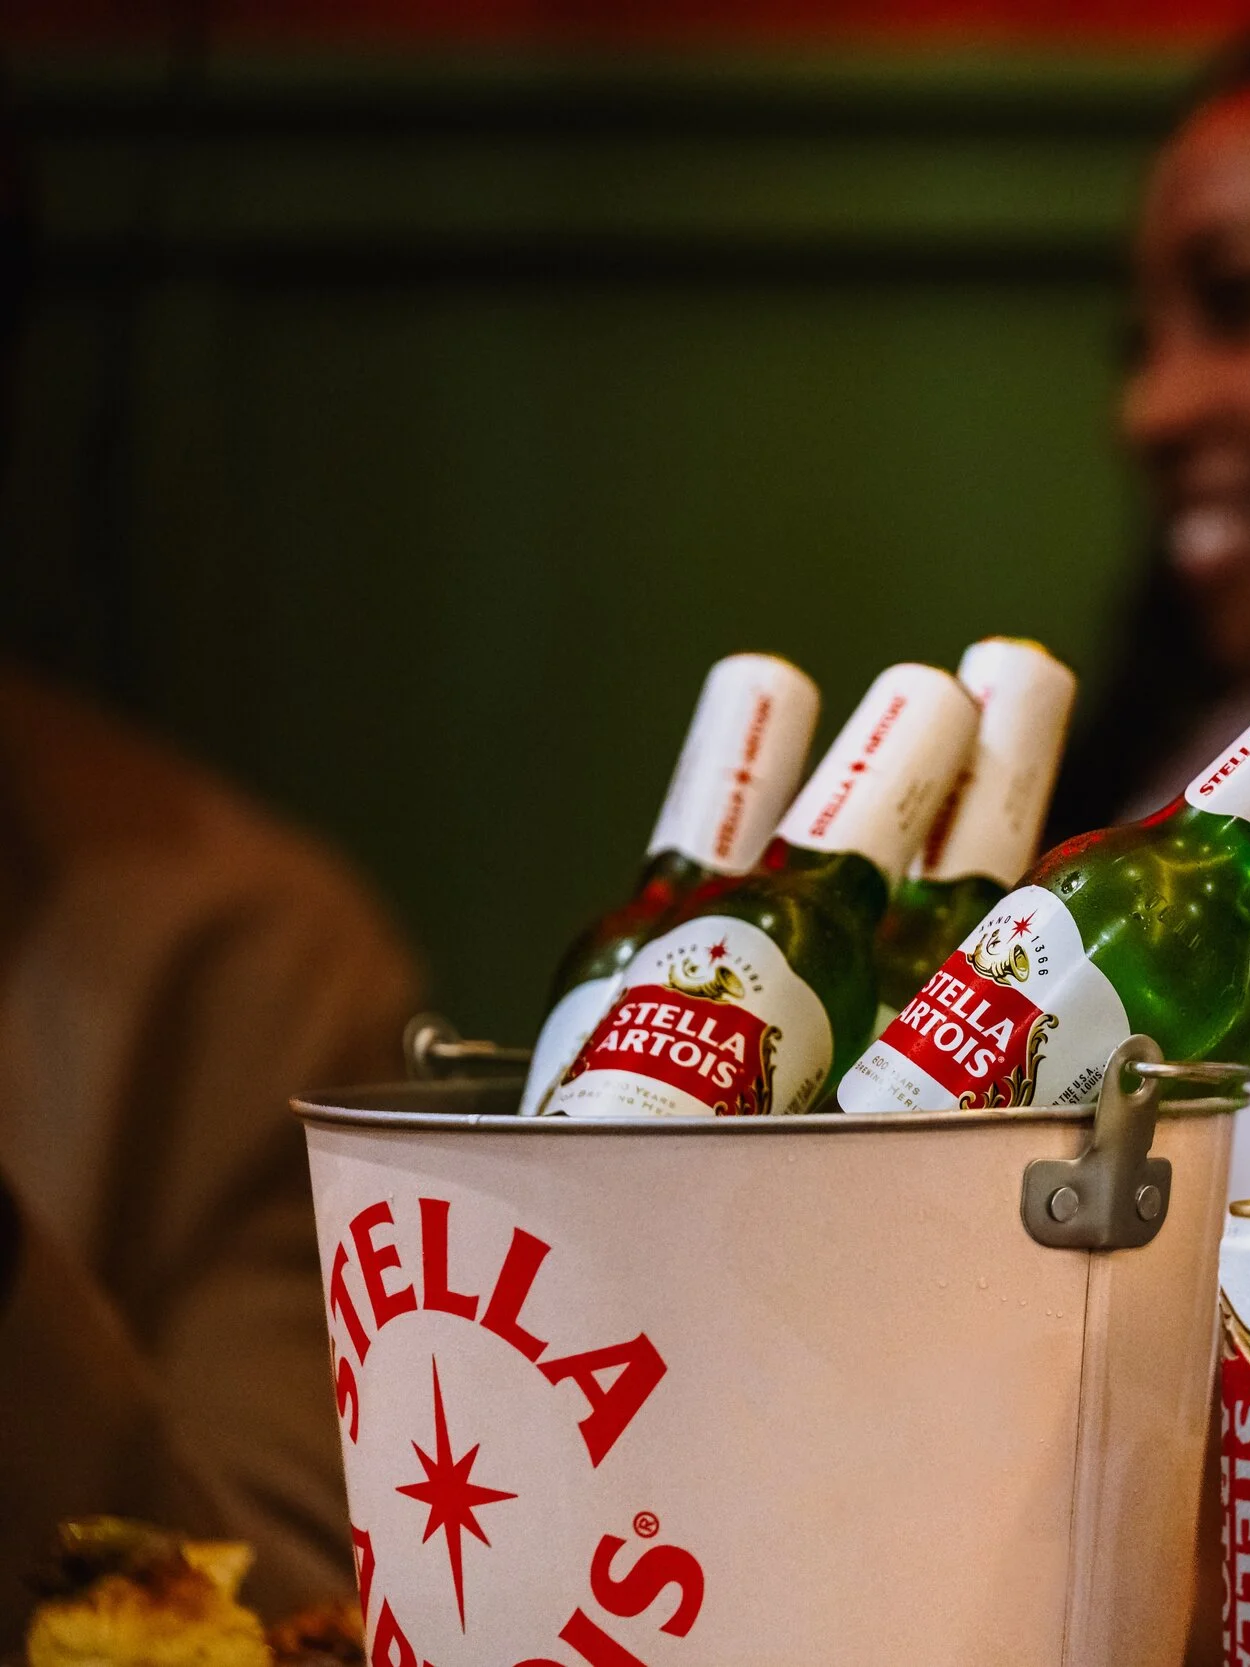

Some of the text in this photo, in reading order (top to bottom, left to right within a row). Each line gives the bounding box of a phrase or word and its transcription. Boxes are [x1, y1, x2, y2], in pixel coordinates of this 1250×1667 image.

[1031, 935, 1049, 976] 1366
[613, 1002, 745, 1064] STELLA
[921, 970, 1014, 1053] STELLA
[595, 1029, 737, 1089] ARTOIS
[1080, 1071, 1102, 1095] LOUIS
[1058, 1086, 1075, 1103] THE
[331, 1197, 667, 1468] STELLA
